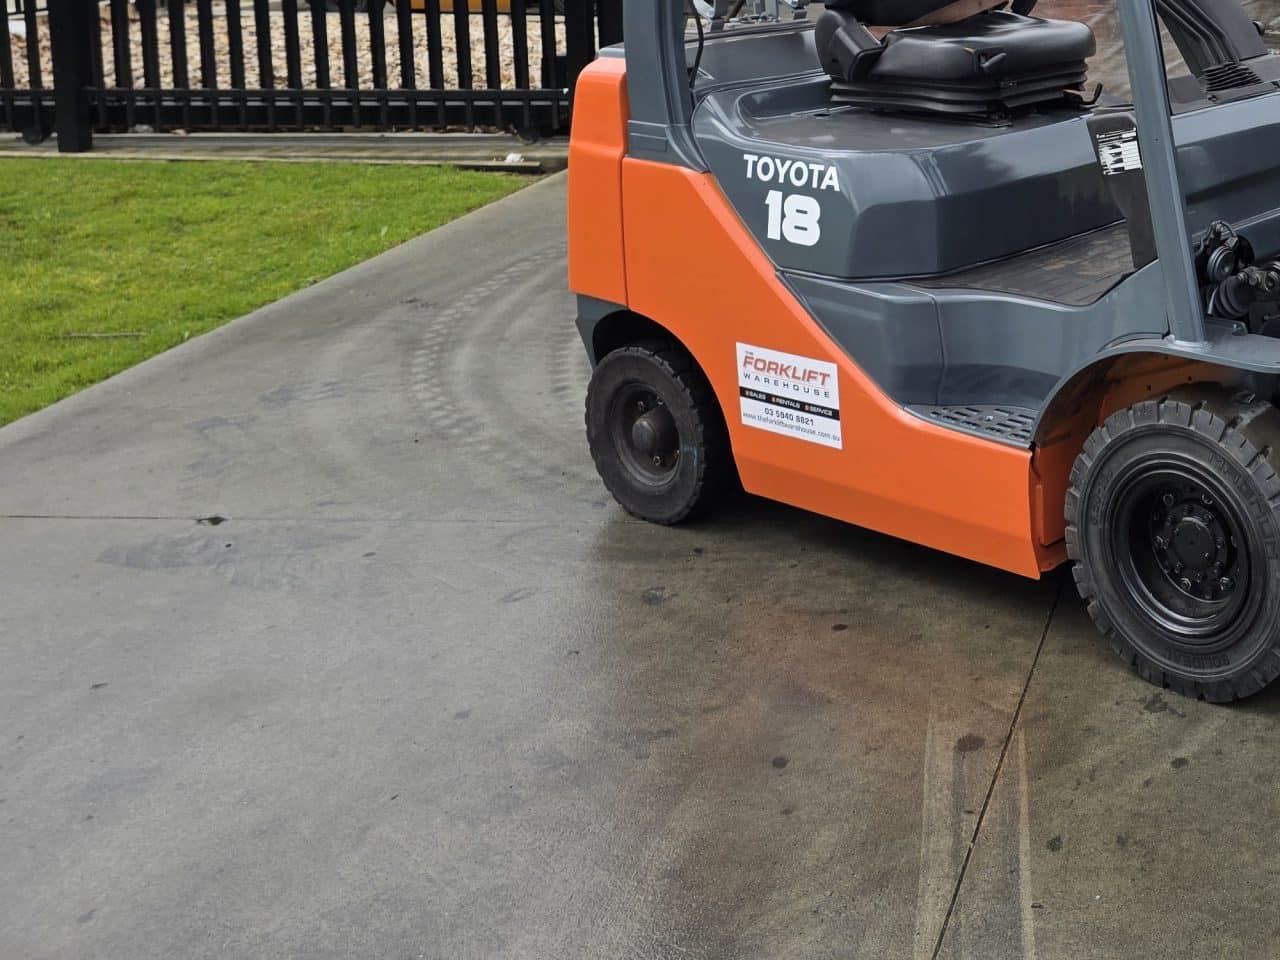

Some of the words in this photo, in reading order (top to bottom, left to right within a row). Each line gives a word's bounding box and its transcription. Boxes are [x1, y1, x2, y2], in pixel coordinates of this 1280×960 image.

[743, 153, 840, 191] TOYOTA
[764, 189, 820, 247] 18
[743, 355, 830, 386] FORKLIFT
[743, 372, 830, 398] WAREHOUSE
[749, 390, 767, 400] SALES
[764, 407, 774, 417] 03
